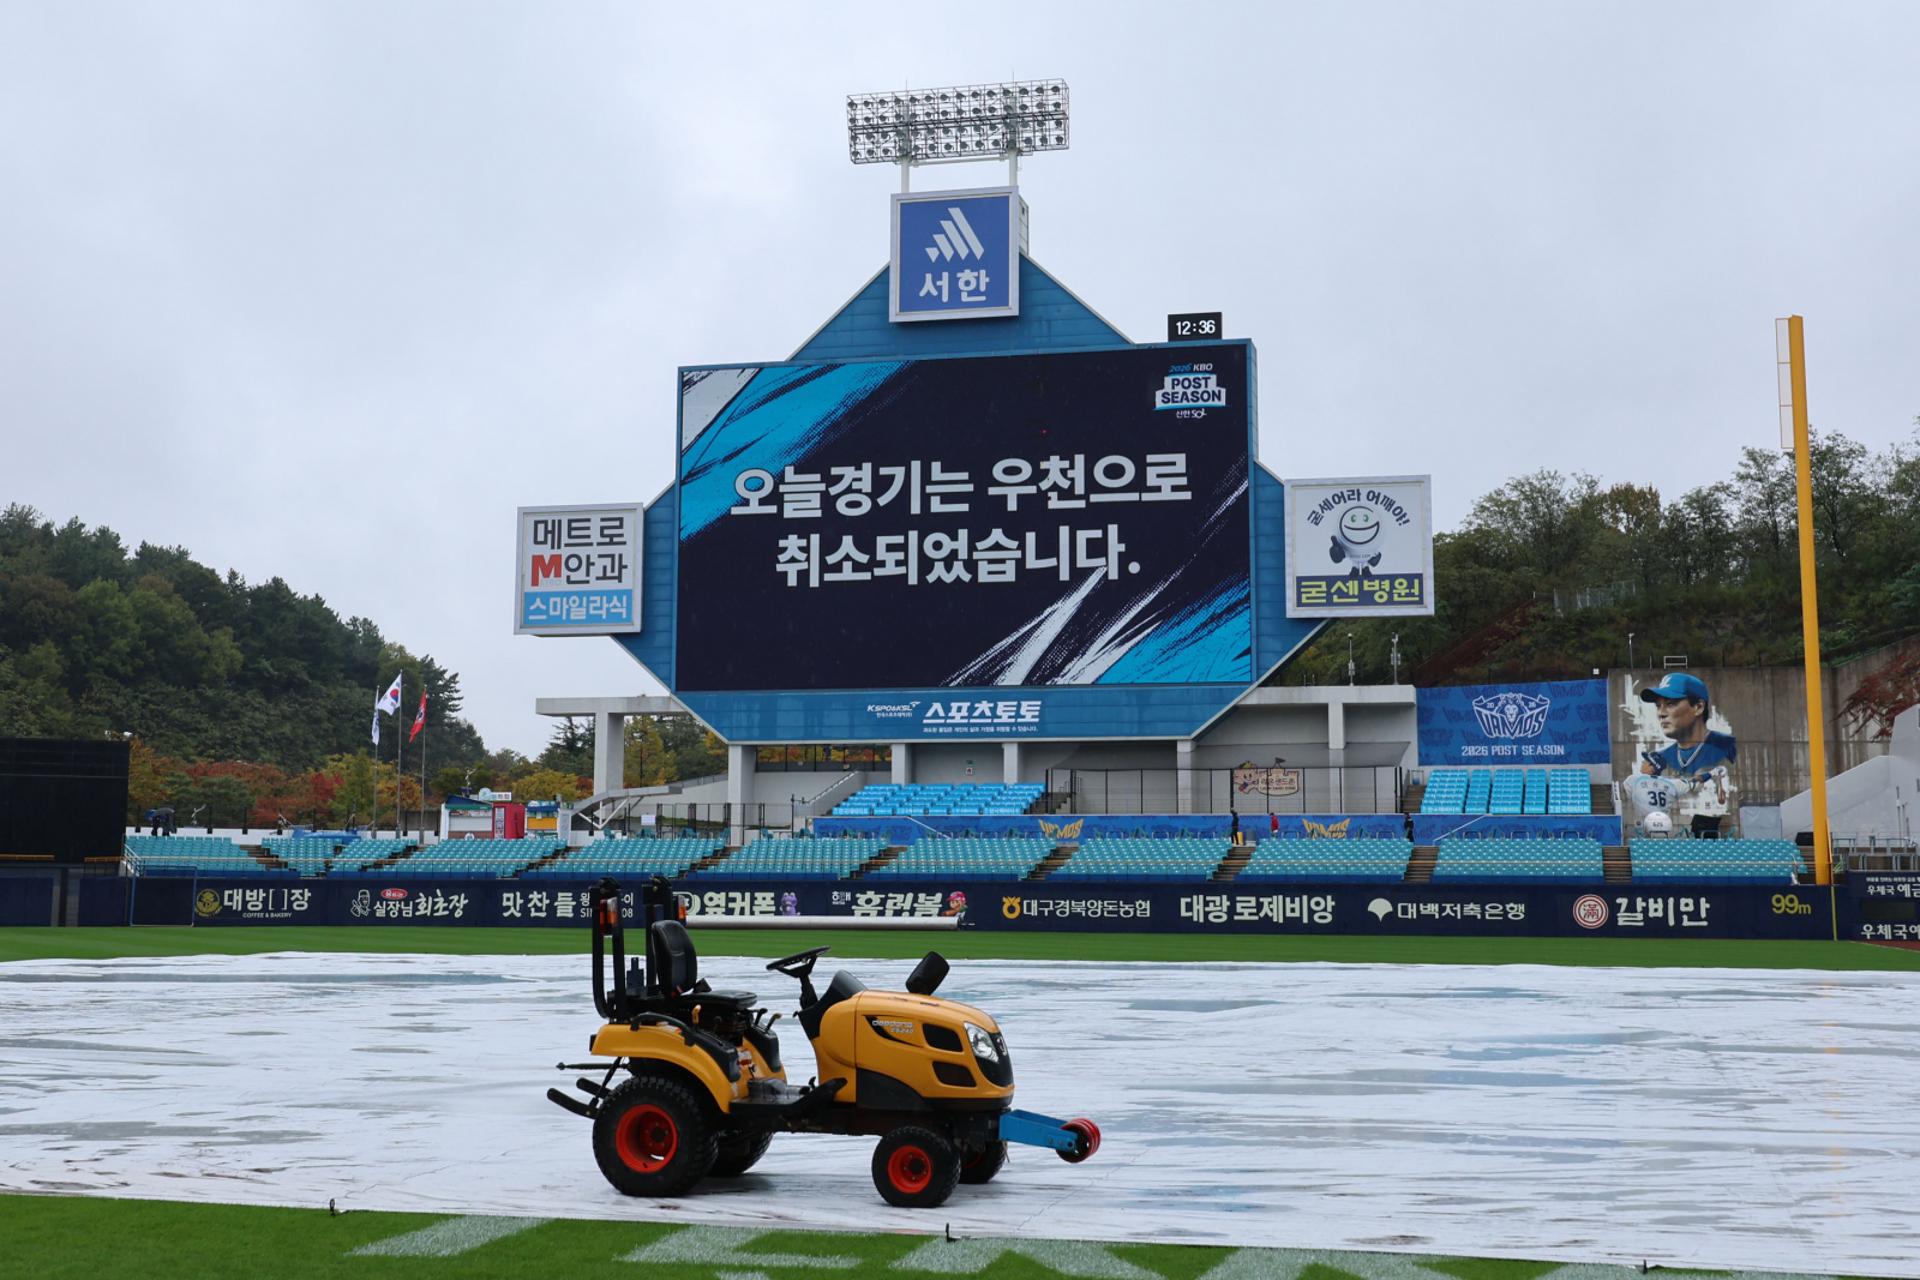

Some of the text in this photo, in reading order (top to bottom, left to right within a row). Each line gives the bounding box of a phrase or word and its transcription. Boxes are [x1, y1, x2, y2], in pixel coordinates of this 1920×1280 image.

[919, 269, 990, 303] 서한
[1176, 320, 1215, 335] 12:36
[1193, 363, 1213, 371] KBO
[1171, 376, 1211, 390] POST
[1161, 389, 1221, 404] SEASON
[730, 453, 1192, 518] 오늘경기는 우천으로
[1307, 488, 1410, 526] 굳세어라 어깨야!
[533, 517, 627, 549] 메트로
[776, 524, 1140, 588] 취소되었습니다.
[531, 553, 628, 587] M안과
[1301, 578, 1420, 604] 굳센병원
[528, 595, 627, 620] 스마일라식
[922, 700, 1042, 724] 스포츠토토
[1474, 706, 1549, 740] VAMOS
[1491, 744, 1518, 756] POST
[1521, 744, 1565, 756] SEASON
[1648, 790, 1667, 807] 36
[1867, 884, 1895, 896] 우체국
[374, 900, 413, 918] 실장님
[415, 888, 469, 918] 회초장
[502, 890, 576, 918] 맛찬들
[1023, 899, 1150, 918] 대구경북양돈농협
[1180, 895, 1335, 924] 대광 로제비앙
[1397, 902, 1525, 920] 대백저축은행
[1771, 893, 1812, 915] 99m
